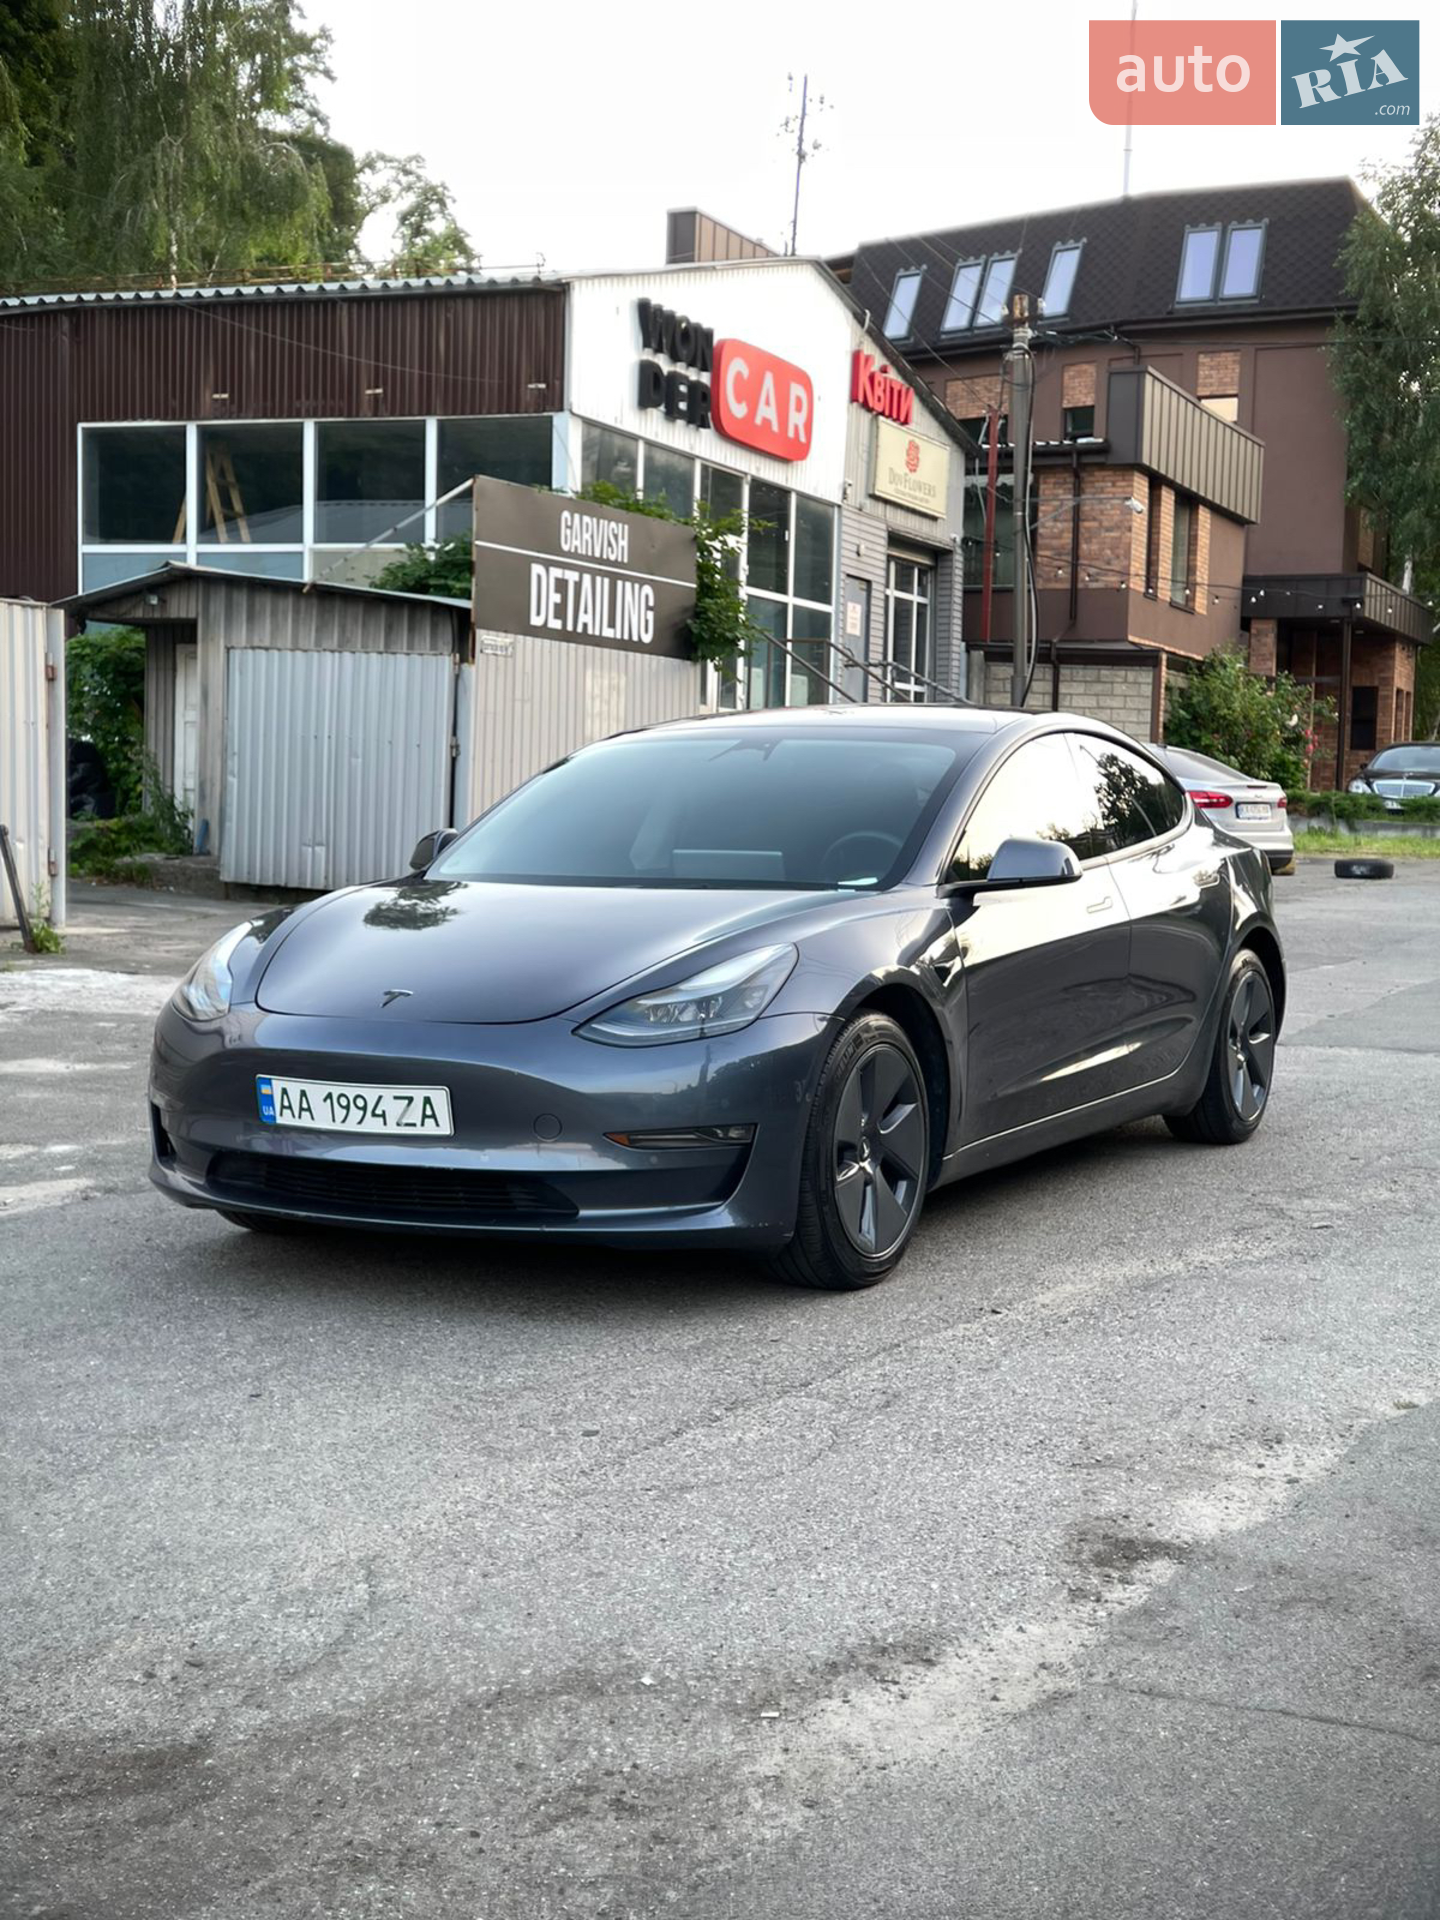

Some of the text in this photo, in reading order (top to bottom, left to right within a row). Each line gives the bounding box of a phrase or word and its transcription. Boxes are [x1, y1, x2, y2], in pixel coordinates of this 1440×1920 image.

[637, 297, 714, 373] WON
[638, 359, 712, 430] DER
[725, 357, 808, 444] CAR
[851, 350, 914, 426] Квіти
[560, 510, 629, 563] GARVISH
[529, 563, 655, 644] DETAILING
[279, 1087, 440, 1127] AA 1994 ZA
